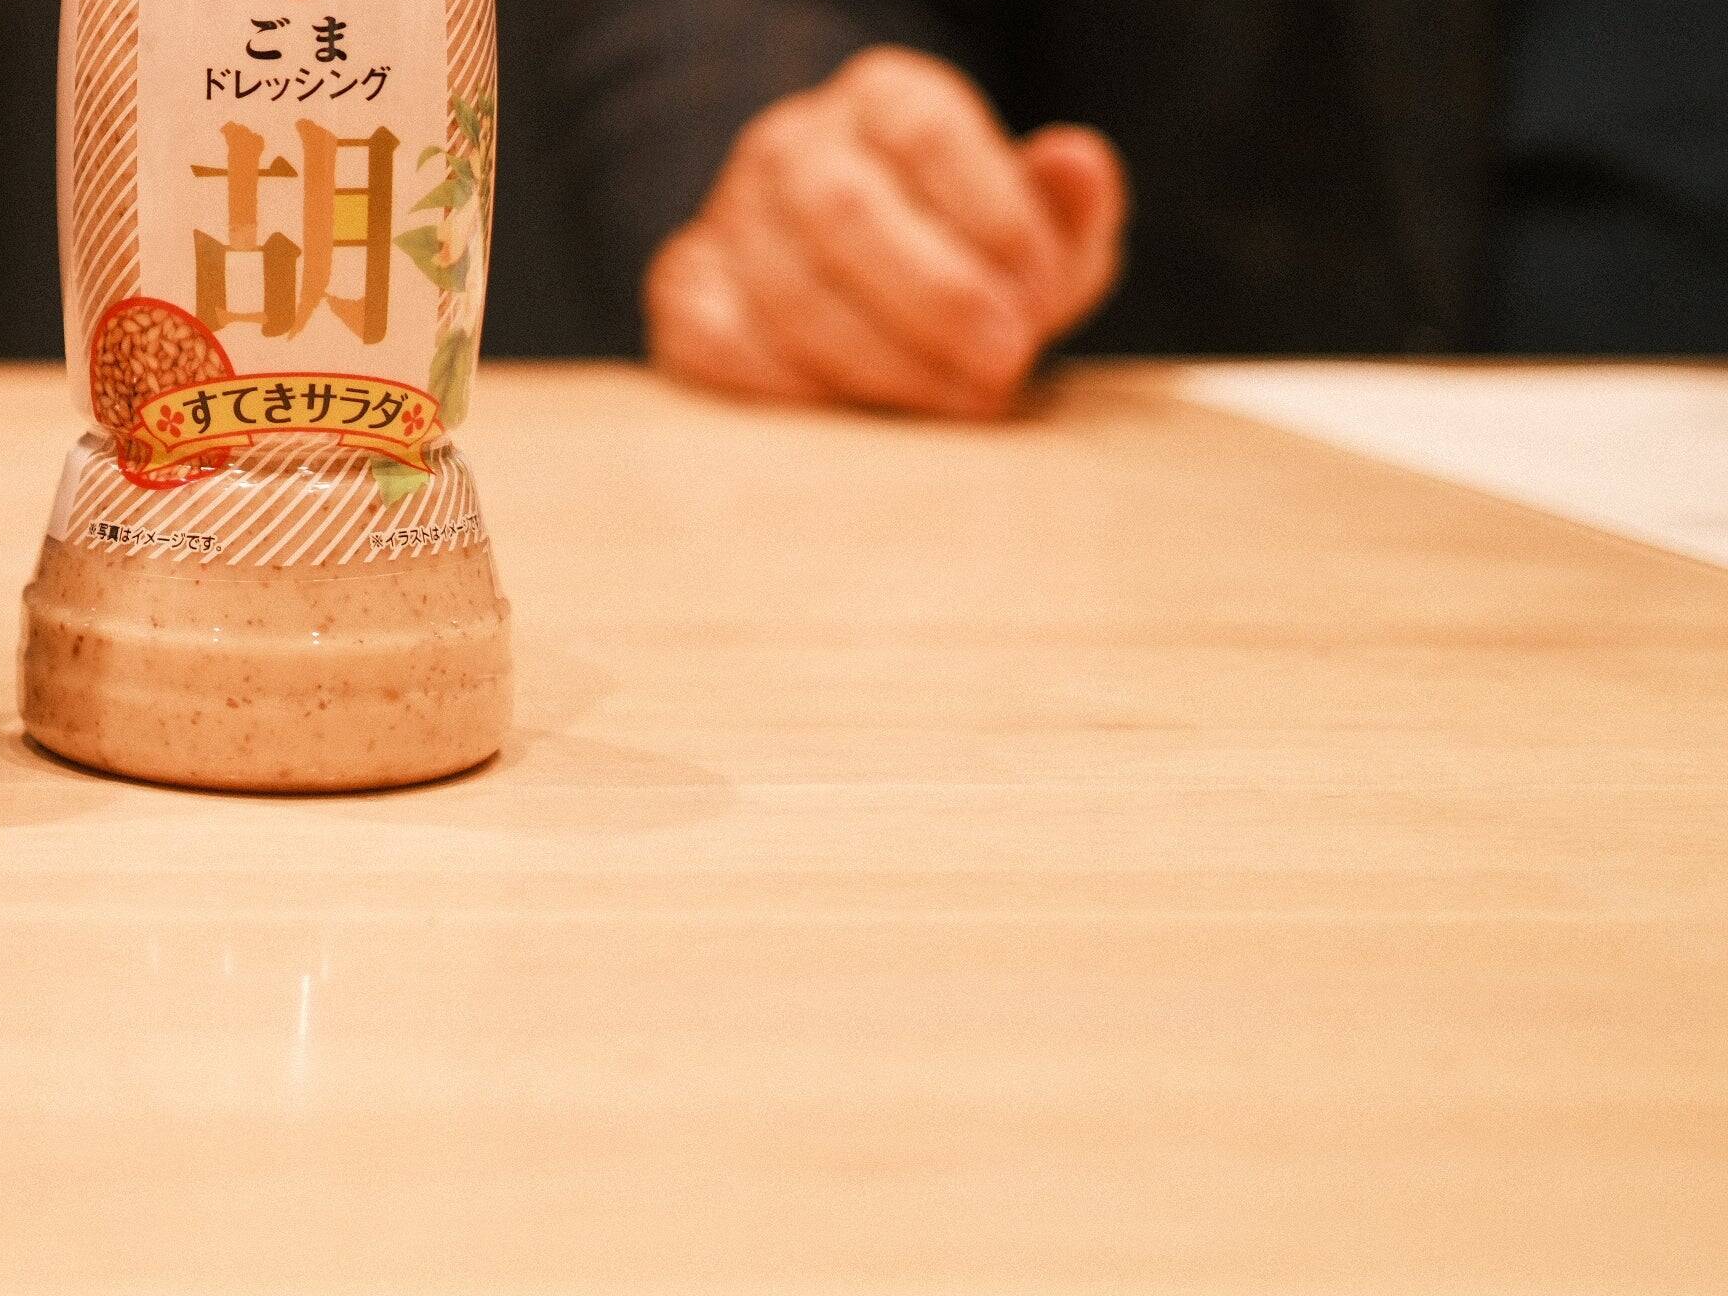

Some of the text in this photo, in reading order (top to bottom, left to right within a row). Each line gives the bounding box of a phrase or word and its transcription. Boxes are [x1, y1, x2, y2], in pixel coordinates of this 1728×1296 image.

[205, 66, 392, 102] ドレッシング
[190, 118, 401, 345] 胡
[182, 383, 408, 434] すてきサラダ
